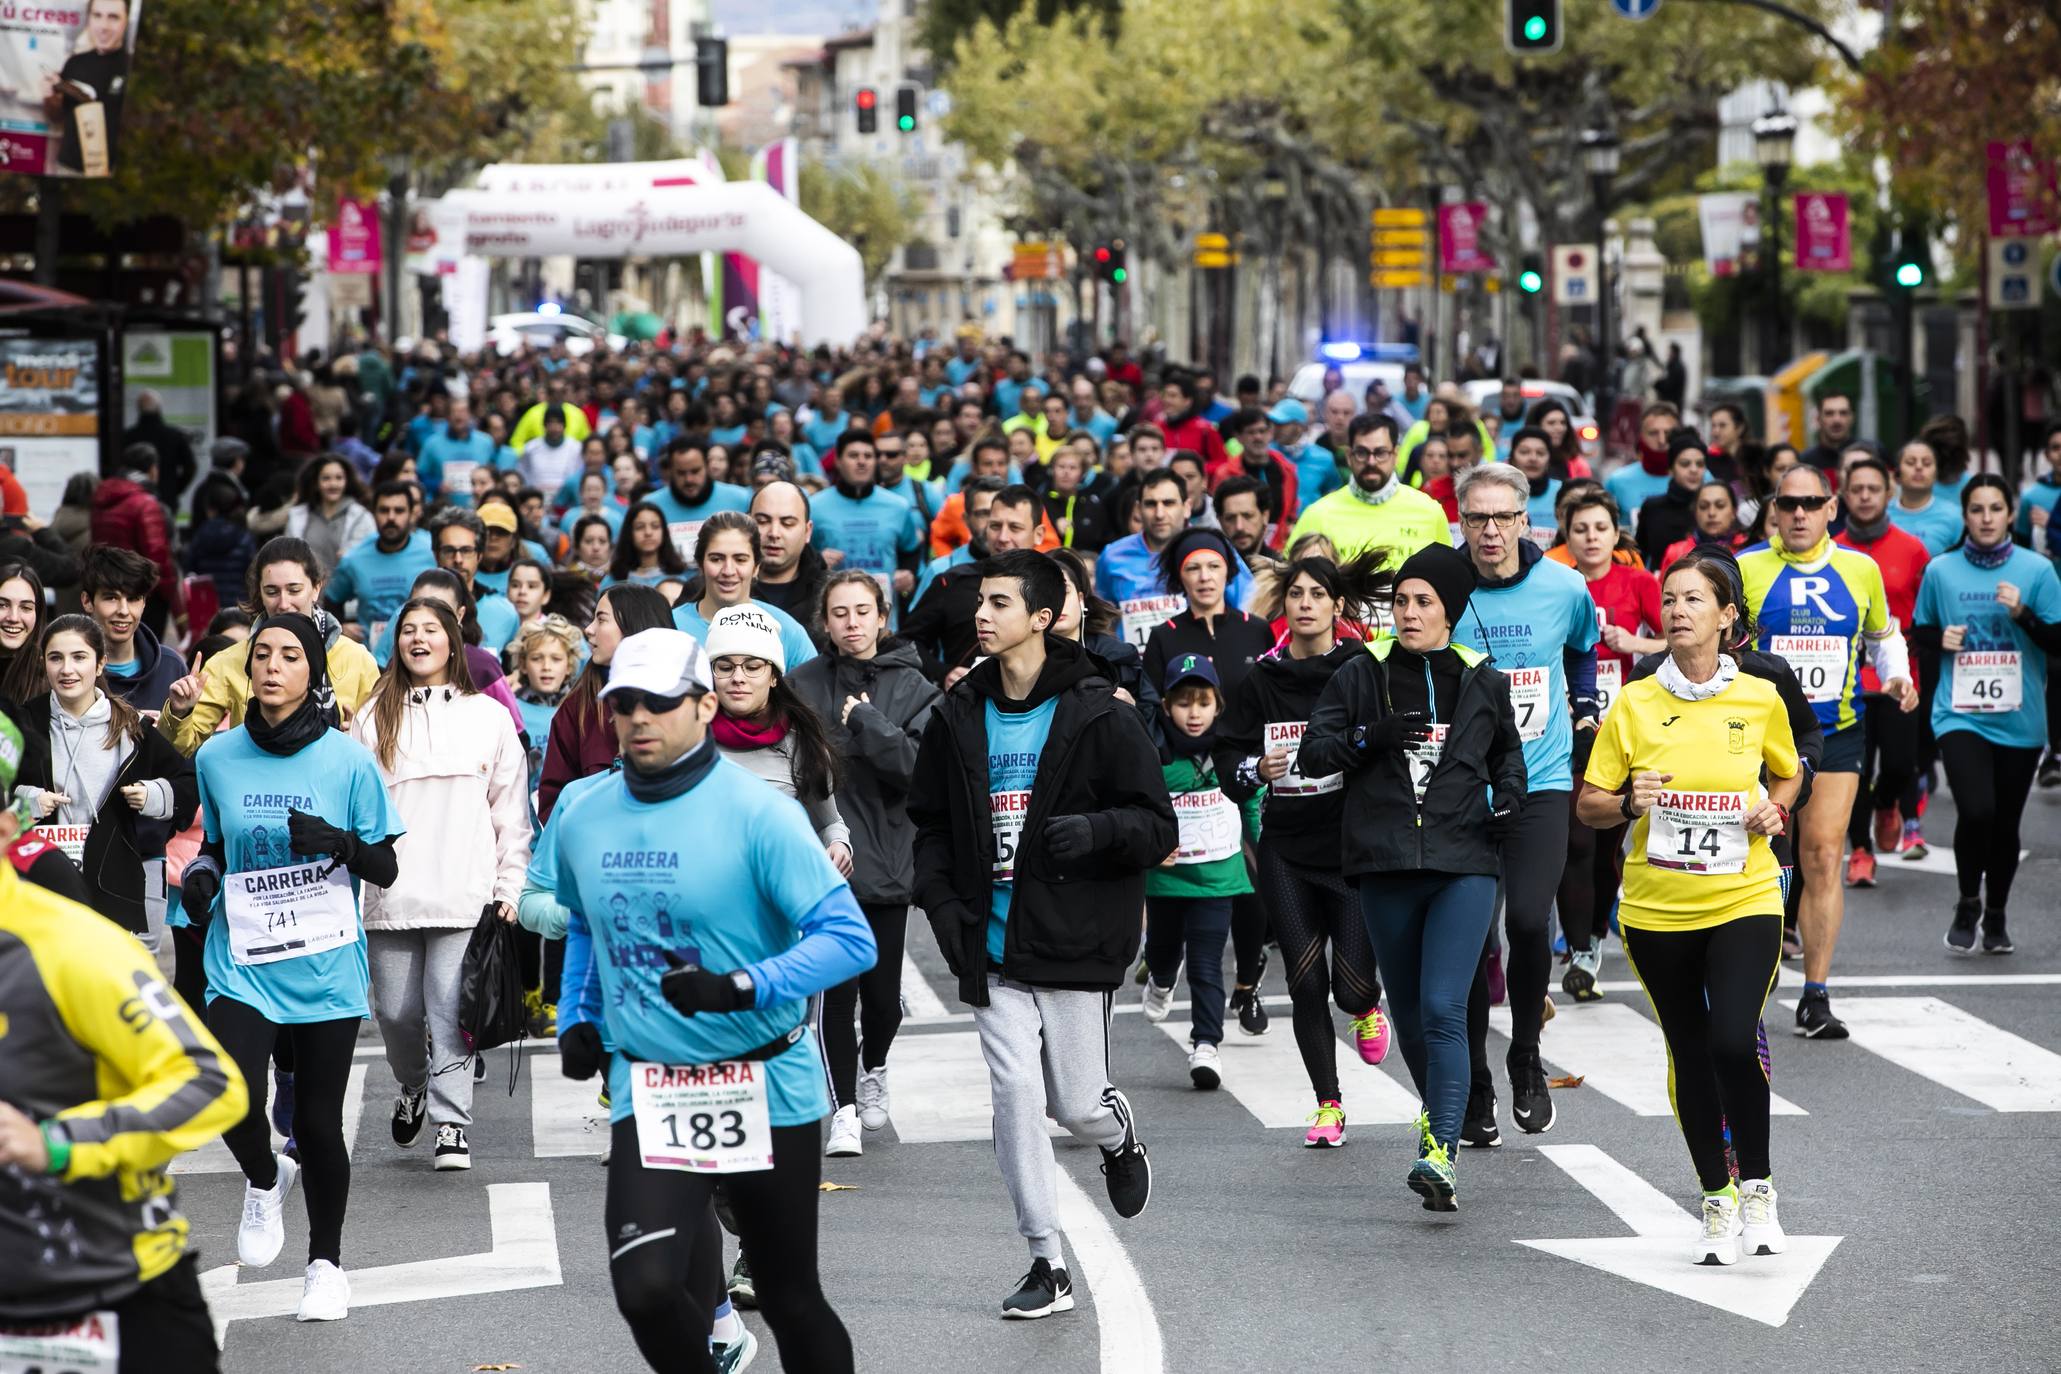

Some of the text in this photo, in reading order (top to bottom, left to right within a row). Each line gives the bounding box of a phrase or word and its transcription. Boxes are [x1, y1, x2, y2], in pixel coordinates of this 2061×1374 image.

[0, 0, 80, 26] ú creas
[5, 360, 78, 390] tour
[1790, 576, 1847, 621] R
[720, 612, 764, 626] DON'T
[1473, 624, 1532, 639] CARRERA
[1790, 625, 1826, 634] RIOJA
[1776, 639, 1841, 651] CARRERA
[1958, 655, 2017, 666] CARRERA
[1507, 670, 1542, 687] ERA
[1793, 666, 1826, 688] 10
[1972, 679, 2004, 699] 46
[1518, 703, 1535, 728] 7
[1418, 760, 1436, 786] 2
[244, 794, 313, 810] CARRERA
[1657, 792, 1742, 812] CARRERA
[1677, 828, 1721, 856] 14
[601, 852, 679, 869] CARRERA
[244, 866, 328, 894] CARRERA
[304, 885, 324, 894] FAMILIA
[264, 910, 297, 932] 741
[308, 933, 336, 943] LABORAL
[645, 1062, 754, 1088] CARRERA
[662, 1110, 747, 1151] 183
